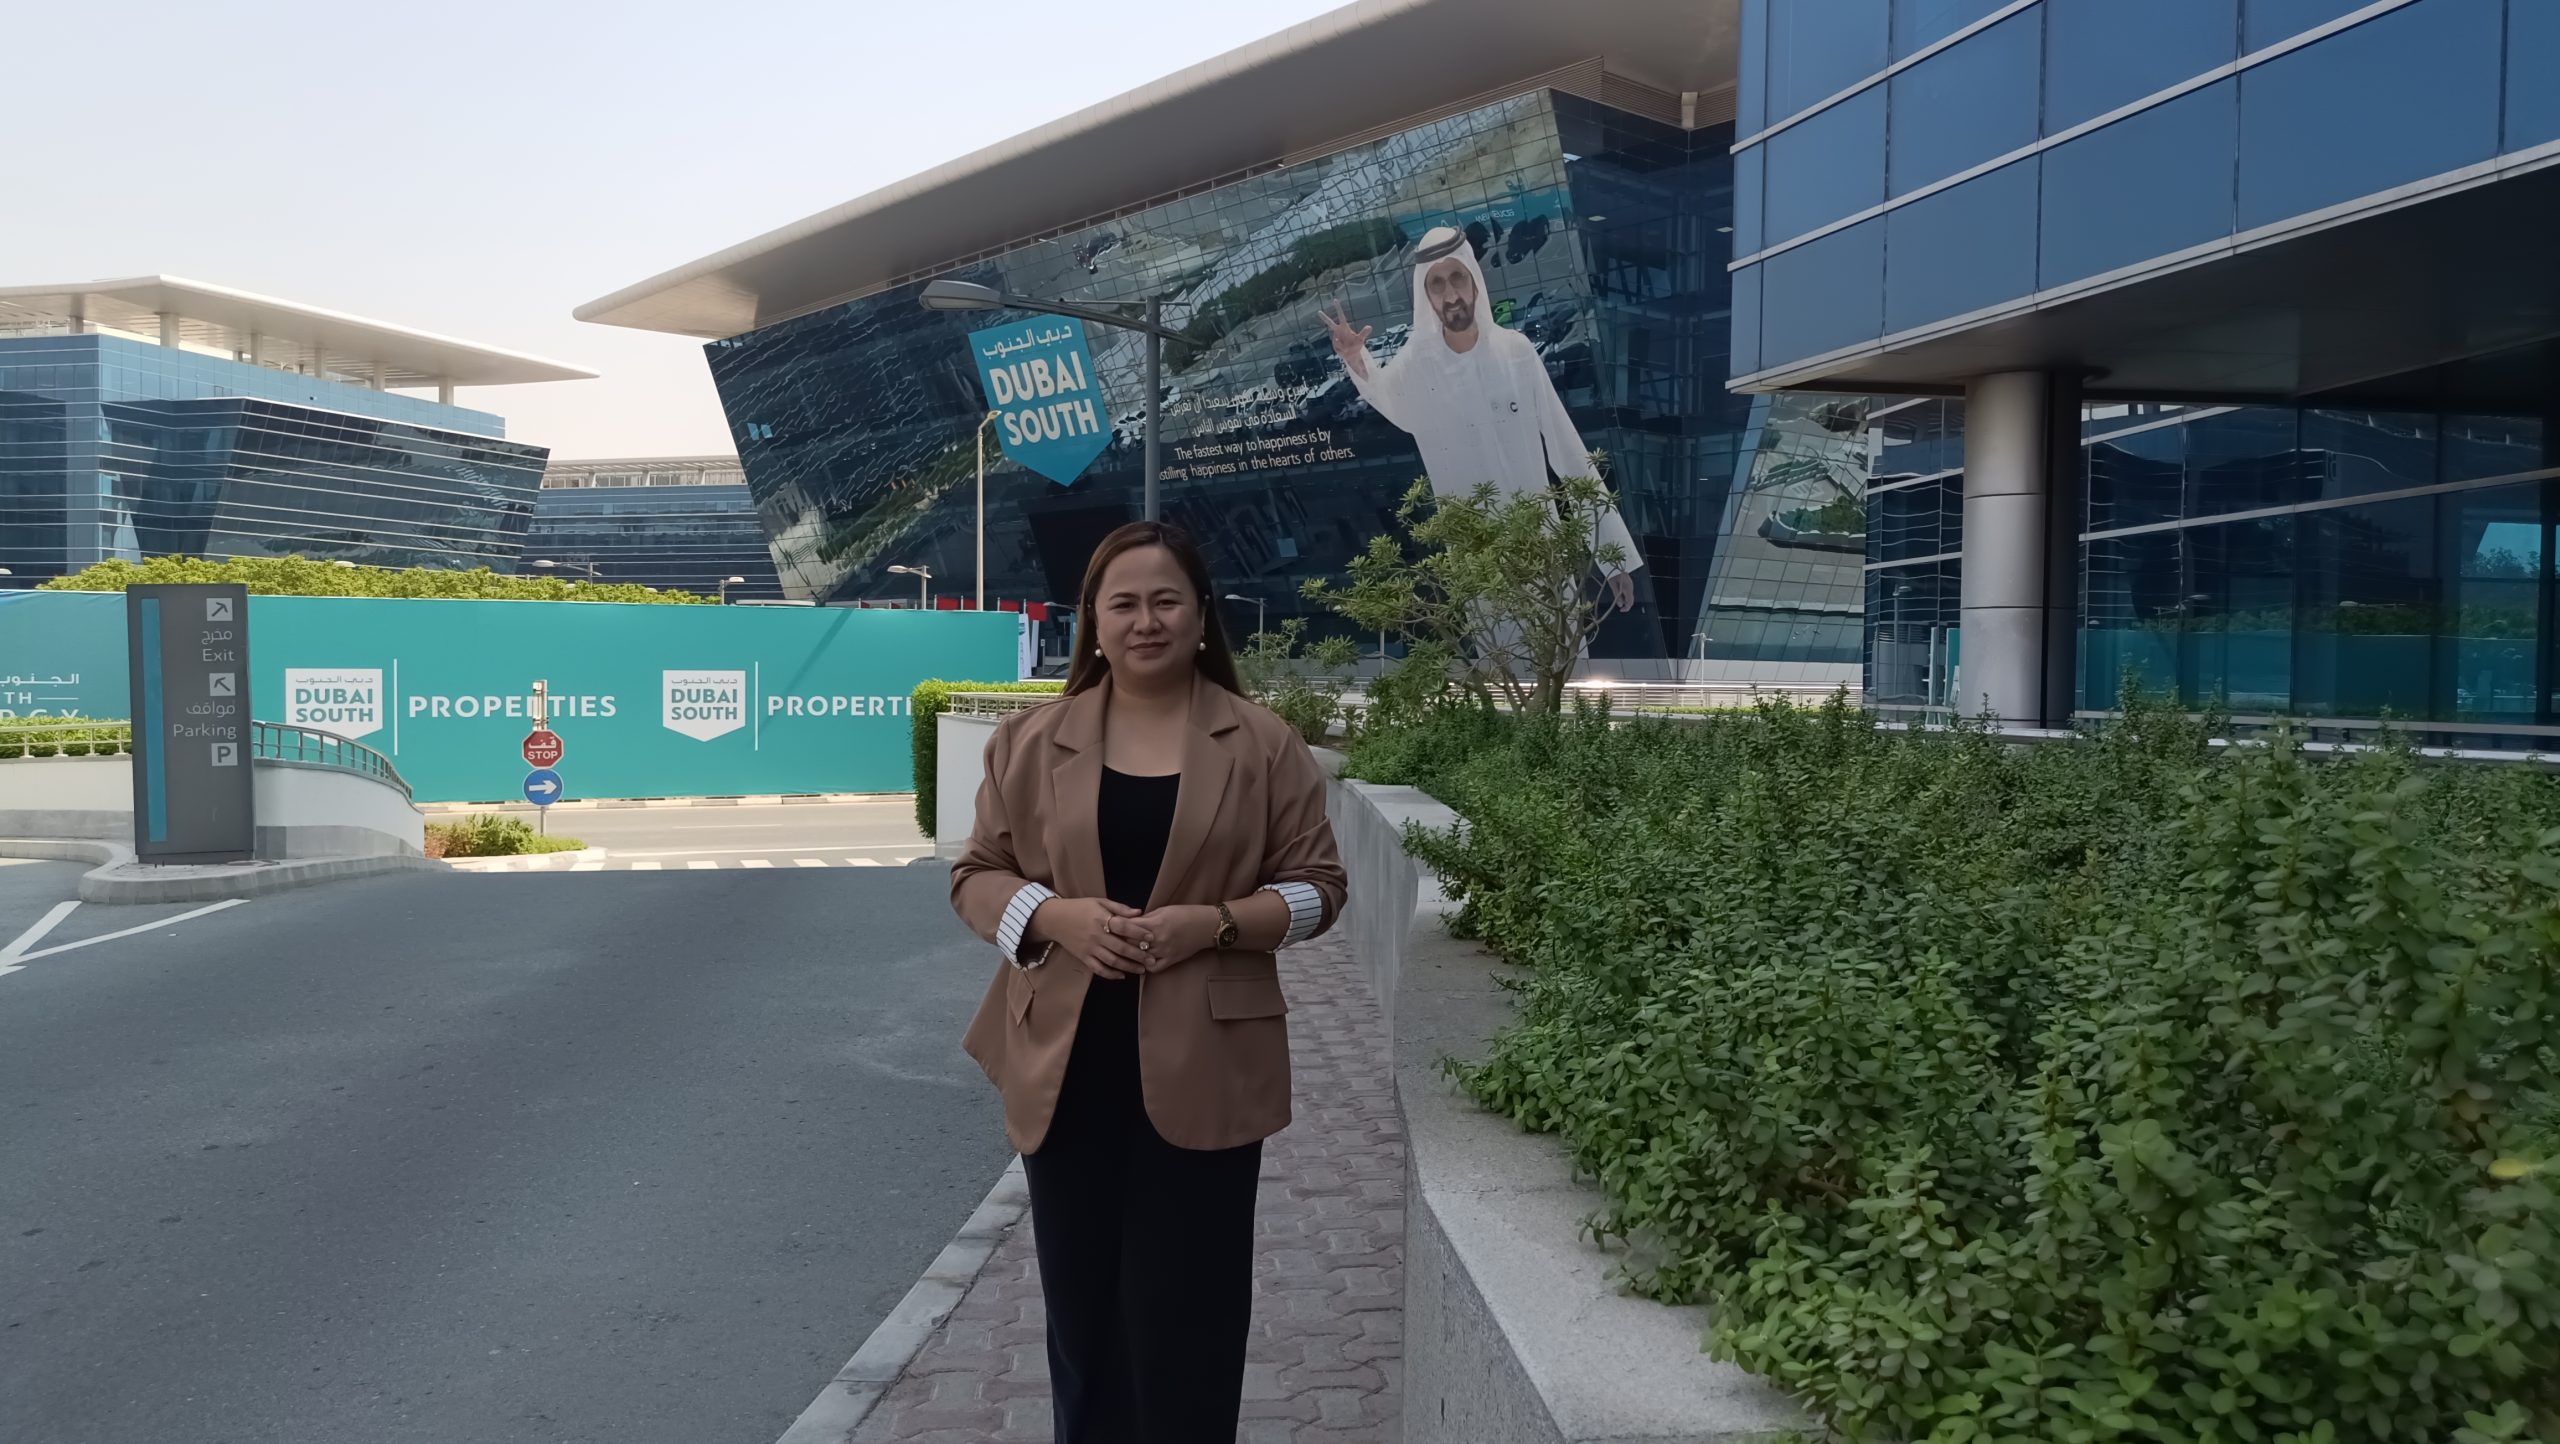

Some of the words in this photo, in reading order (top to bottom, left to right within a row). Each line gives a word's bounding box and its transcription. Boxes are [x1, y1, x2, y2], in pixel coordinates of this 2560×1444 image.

[982, 328, 1036, 358] الجنوب
[1036, 325, 1073, 347] دبي
[989, 351, 1087, 406] DUBAI
[1004, 399, 1100, 446] SOUTH
[1244, 415, 1260, 430] في
[1260, 403, 1297, 425] السعادة
[1216, 417, 1243, 434] نفوس
[1174, 447, 1193, 460] The
[1193, 443, 1224, 459] fastest
[1224, 442, 1244, 456] way
[1246, 440, 1258, 452] to
[1257, 434, 1308, 452] happiness
[1308, 430, 1317, 443] is
[1317, 427, 1331, 444] by
[1159, 466, 1188, 481] stilling
[1190, 463, 1236, 478] happiness
[1238, 459, 1249, 472] in
[1251, 455, 1268, 470] the
[1267, 453, 1301, 468] hearts
[1304, 448, 1315, 463] of
[1320, 445, 1356, 462] others.
[201, 628, 233, 645] مخرج
[202, 649, 235, 662] Exit
[295, 688, 373, 705] DUBAI
[671, 688, 738, 704] DUBAI
[186, 700, 235, 718] مواقف
[671, 706, 738, 720] SOUTH
[767, 695, 912, 717] PROPERTI
[295, 707, 374, 723] SOUTH
[173, 723, 237, 740] Parking
[528, 736, 557, 749] قف
[216, 745, 232, 764] P
[527, 750, 559, 760] STOP
